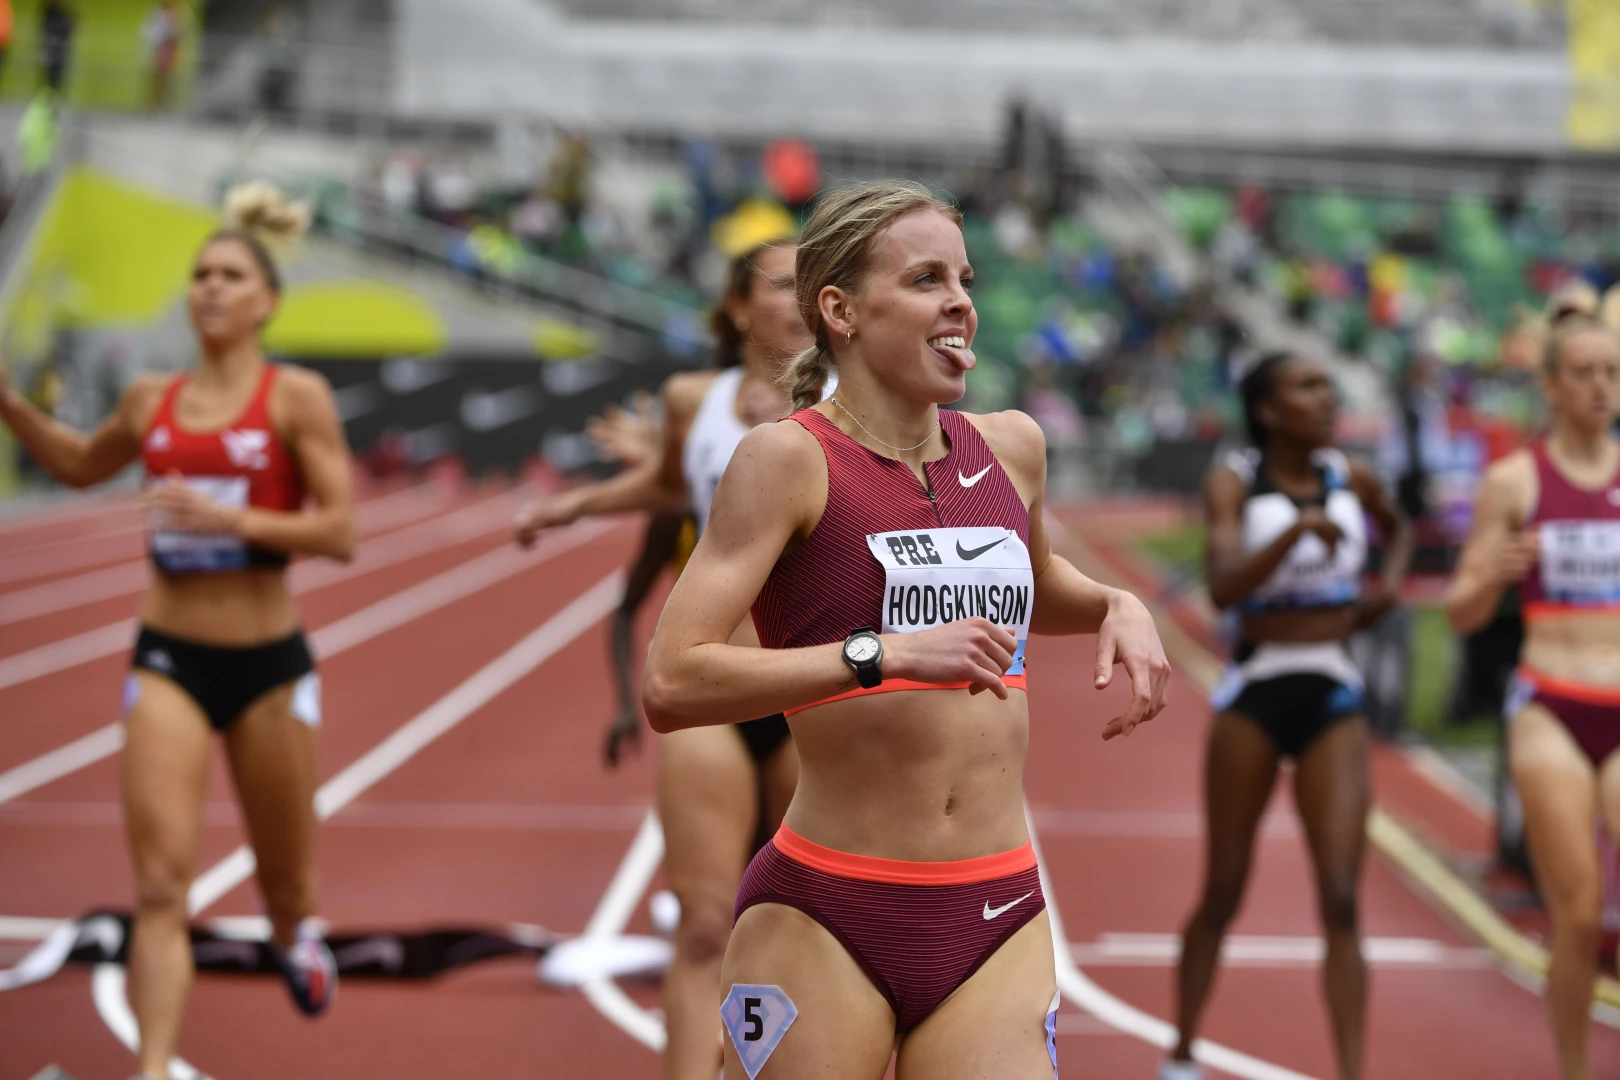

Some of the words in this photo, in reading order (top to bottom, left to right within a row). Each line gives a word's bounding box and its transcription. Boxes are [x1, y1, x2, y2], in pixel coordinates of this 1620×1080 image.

[886, 534, 942, 565] PRE
[889, 584, 1028, 625] HODGKINSON
[744, 998, 763, 1041] 5
